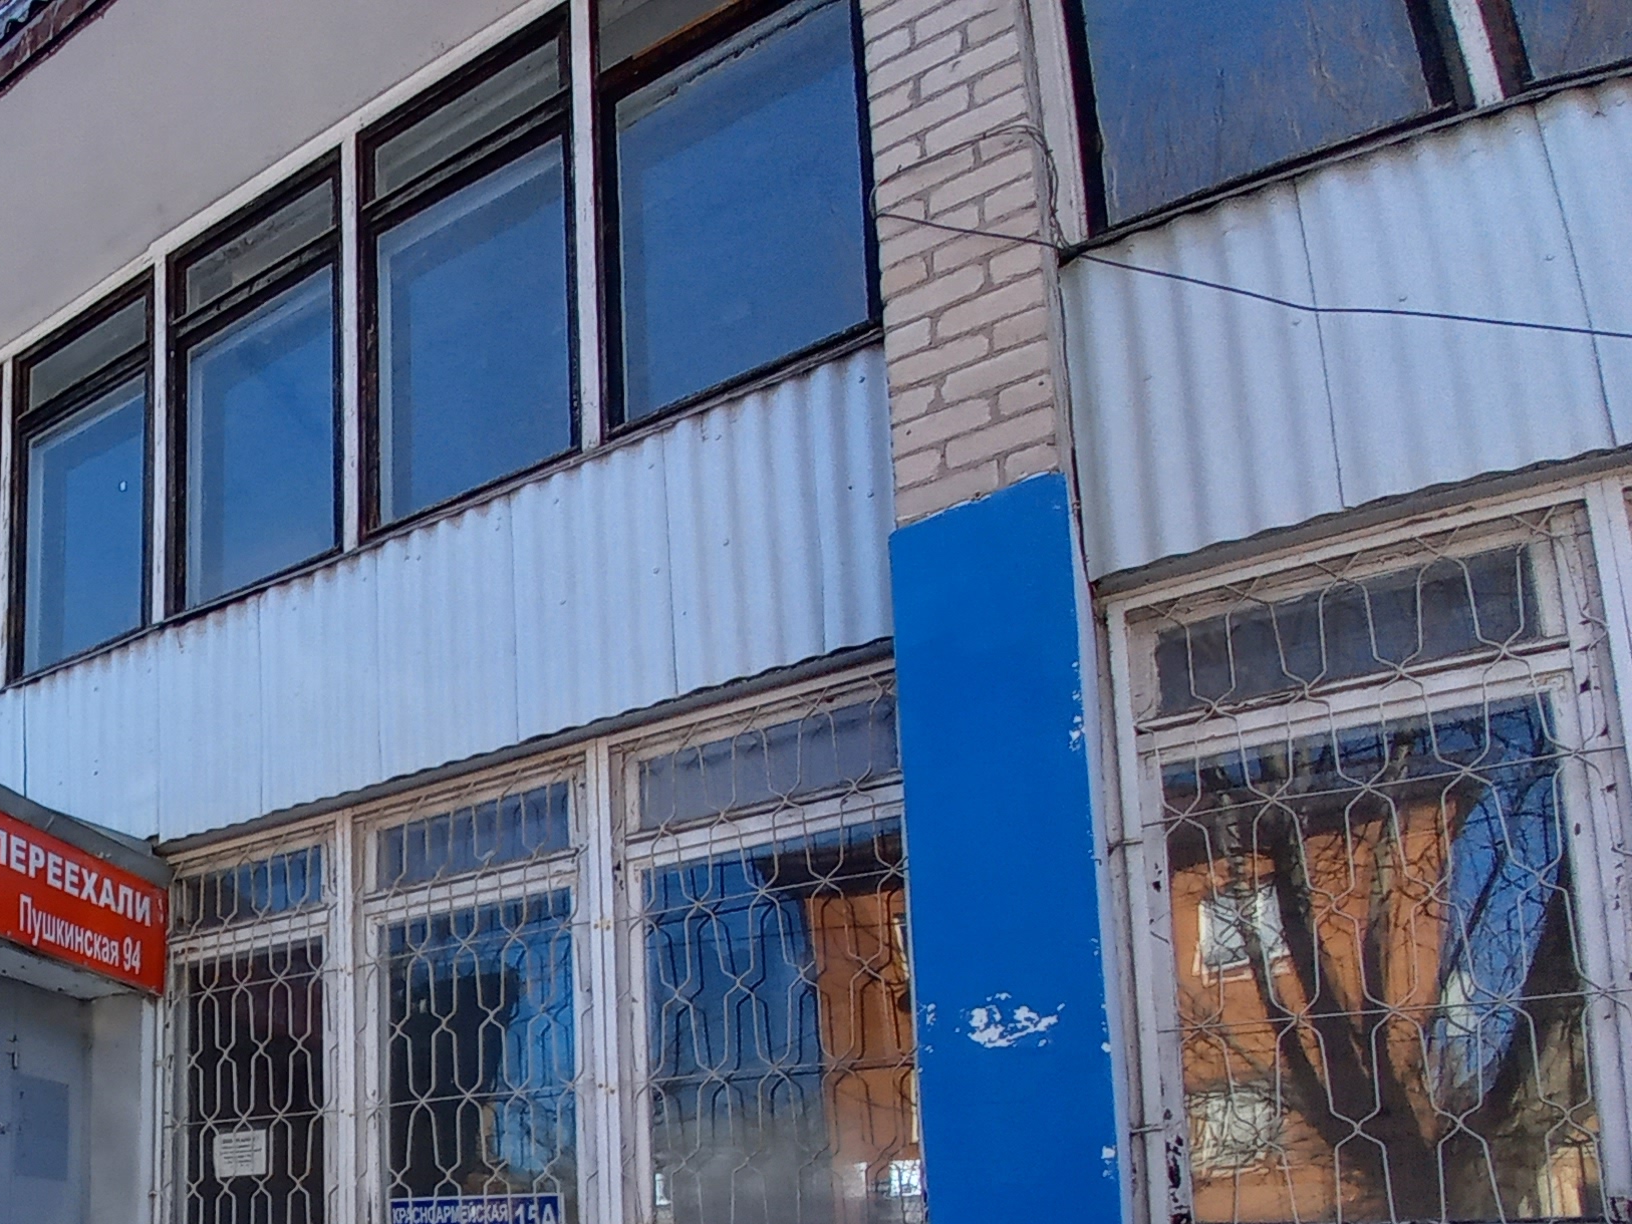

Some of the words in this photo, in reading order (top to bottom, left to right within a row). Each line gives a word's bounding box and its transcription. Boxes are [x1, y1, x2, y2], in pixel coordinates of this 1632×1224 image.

[18, 894, 120, 968] Пушкинская
[123, 936, 142, 975] 94
[391, 1202, 509, 1224] КРАСНОАРМЕЙСКАЯ
